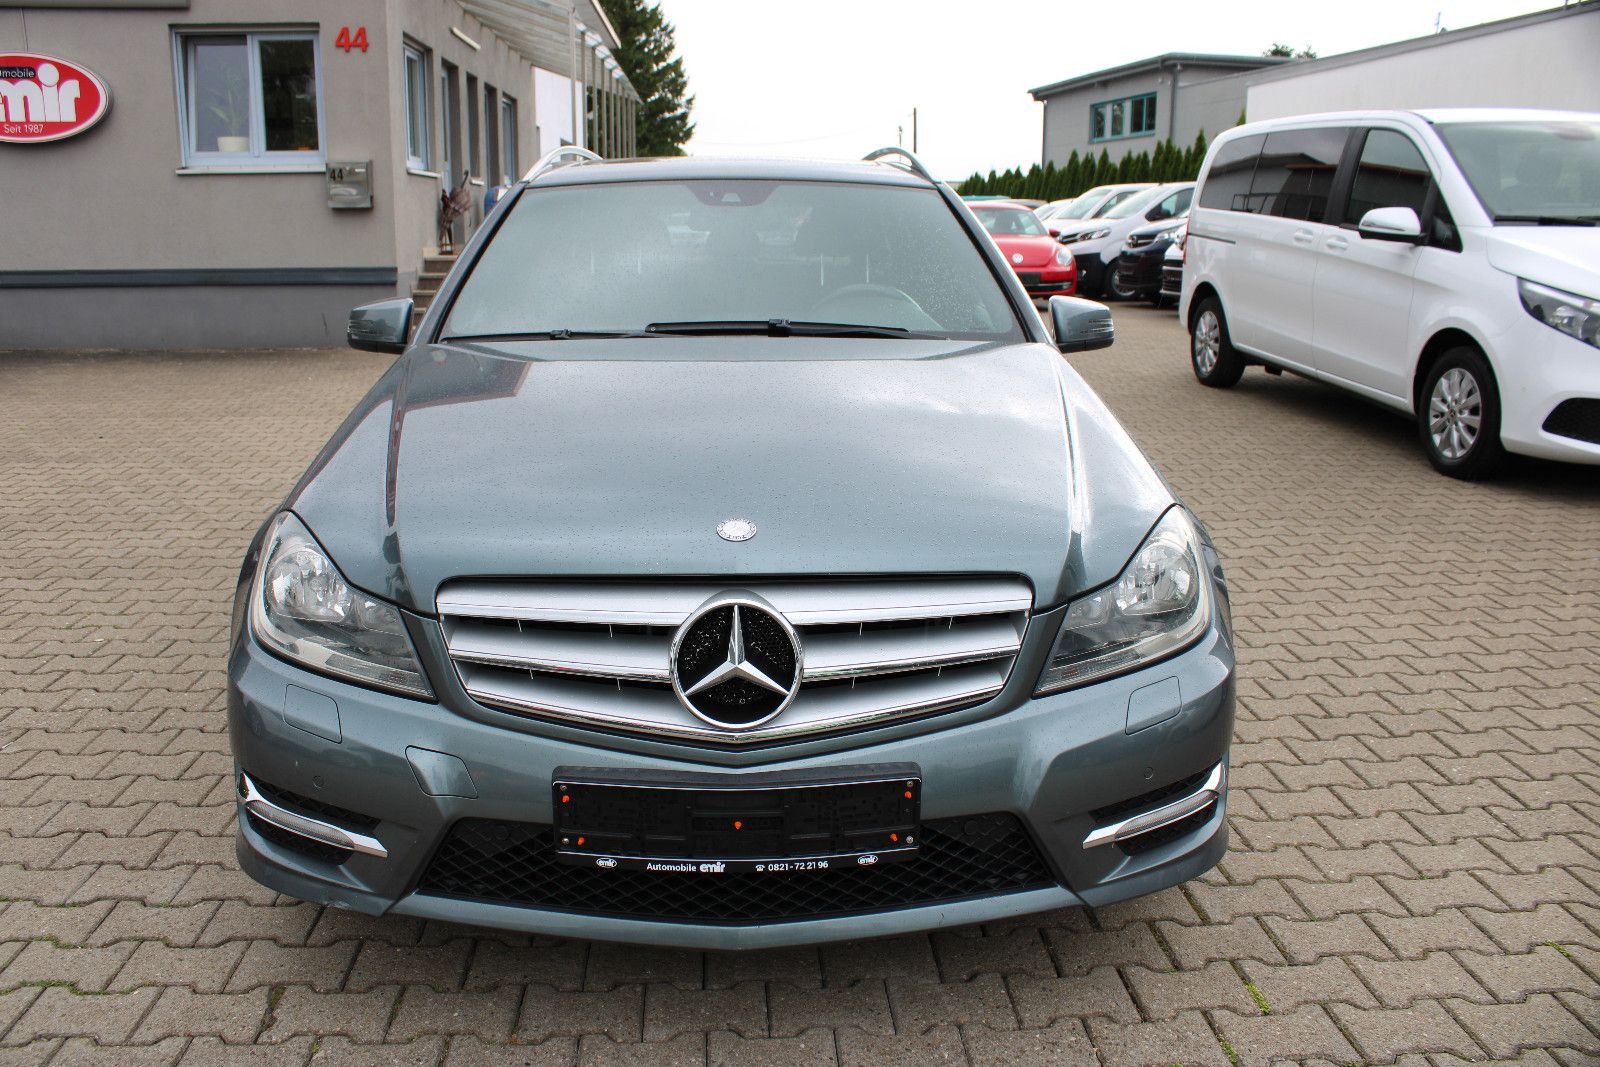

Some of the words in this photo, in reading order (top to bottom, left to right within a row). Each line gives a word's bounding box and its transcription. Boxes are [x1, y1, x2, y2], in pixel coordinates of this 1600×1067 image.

[335, 26, 369, 53] 44
[0, 68, 34, 77] mobile
[4, 123, 22, 134] Seit
[25, 123, 44, 134] 1987
[329, 168, 343, 181] 44
[646, 862, 697, 872] Automobile
[700, 861, 725, 872] emir
